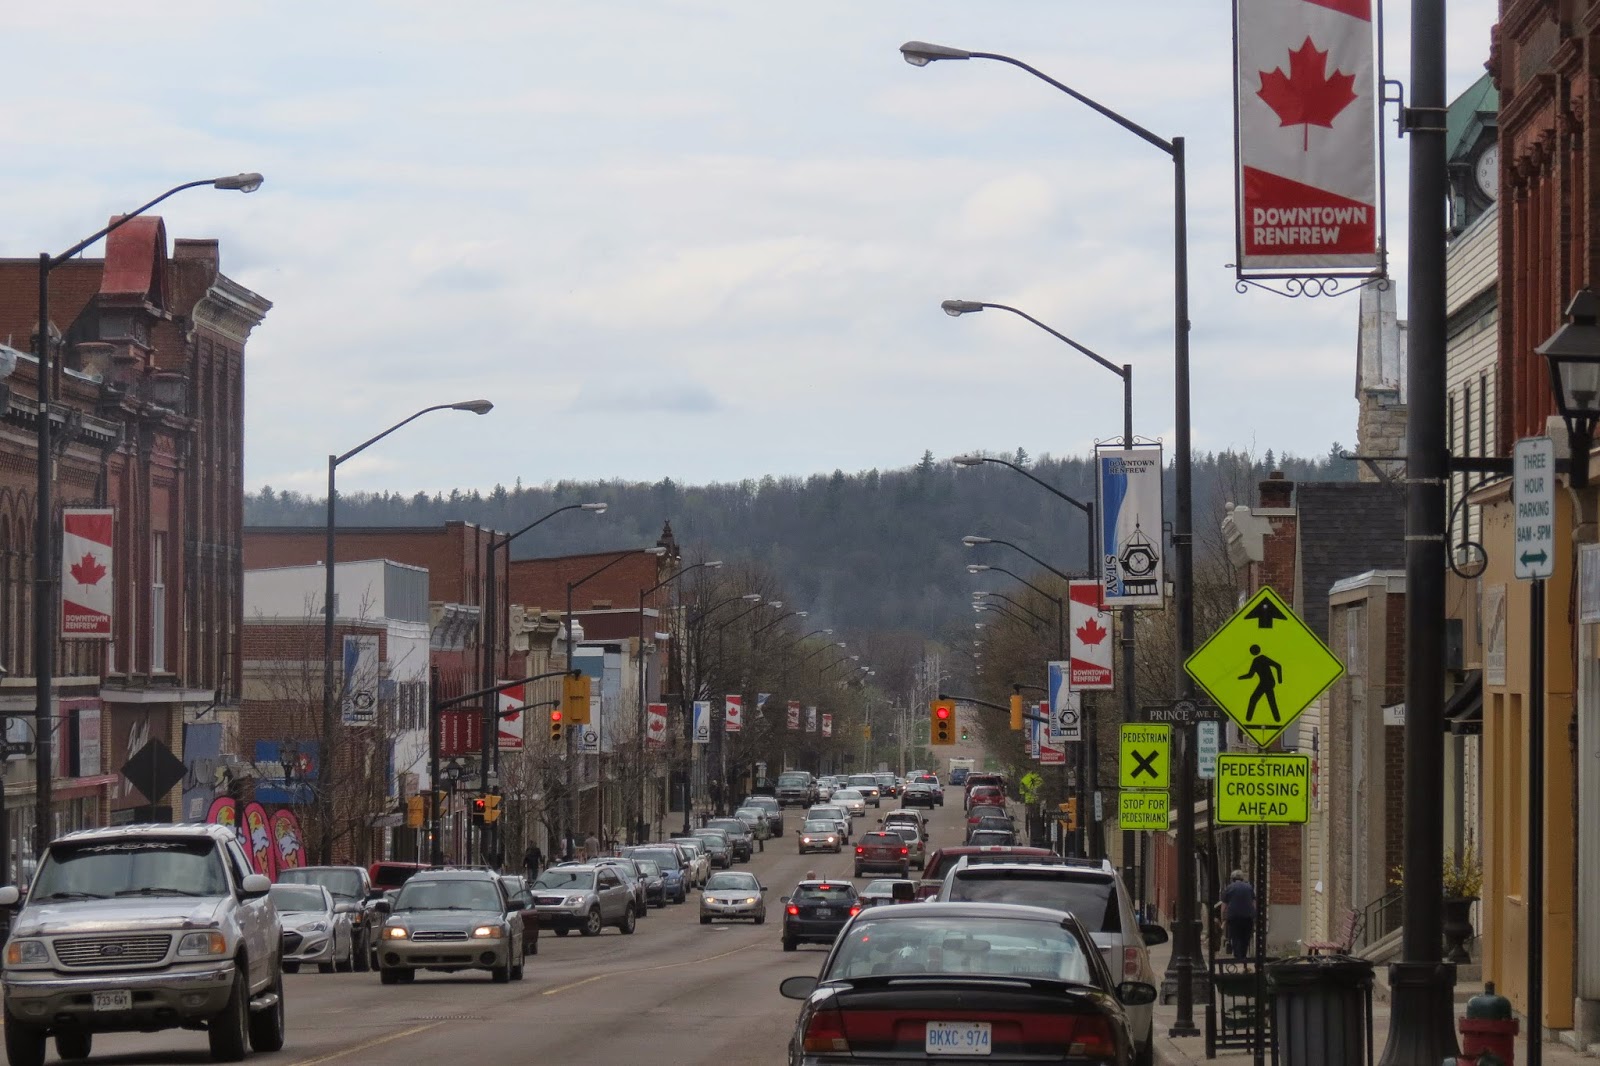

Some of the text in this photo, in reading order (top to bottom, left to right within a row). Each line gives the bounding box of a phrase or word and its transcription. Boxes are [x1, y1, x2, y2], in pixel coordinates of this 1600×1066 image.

[1253, 207, 1367, 226] DOWNTOWN
[1253, 226, 1340, 245] RENFREW
[1109, 459, 1155, 467] DOWNTOWN
[1523, 453, 1546, 470] THREE
[1524, 477, 1544, 494] HOUR
[1519, 501, 1549, 519] PARKING
[1517, 526, 1532, 543] 9AM
[1537, 524, 1551, 540] 5PM
[1105, 555, 1118, 595] STAY
[65, 622, 98, 630] RENFREW
[1150, 710, 1189, 721] PRINCE
[1122, 733, 1167, 743] PEDESTRIAN
[1221, 763, 1305, 777] PEDESTRIAN
[1226, 783, 1299, 797] CROSSING
[1123, 800, 1165, 810] STOP FOR
[1238, 803, 1288, 816] AHEAD
[1122, 812, 1166, 823] PEDESTRIANS
[929, 1029, 989, 1046] BKXC 974
